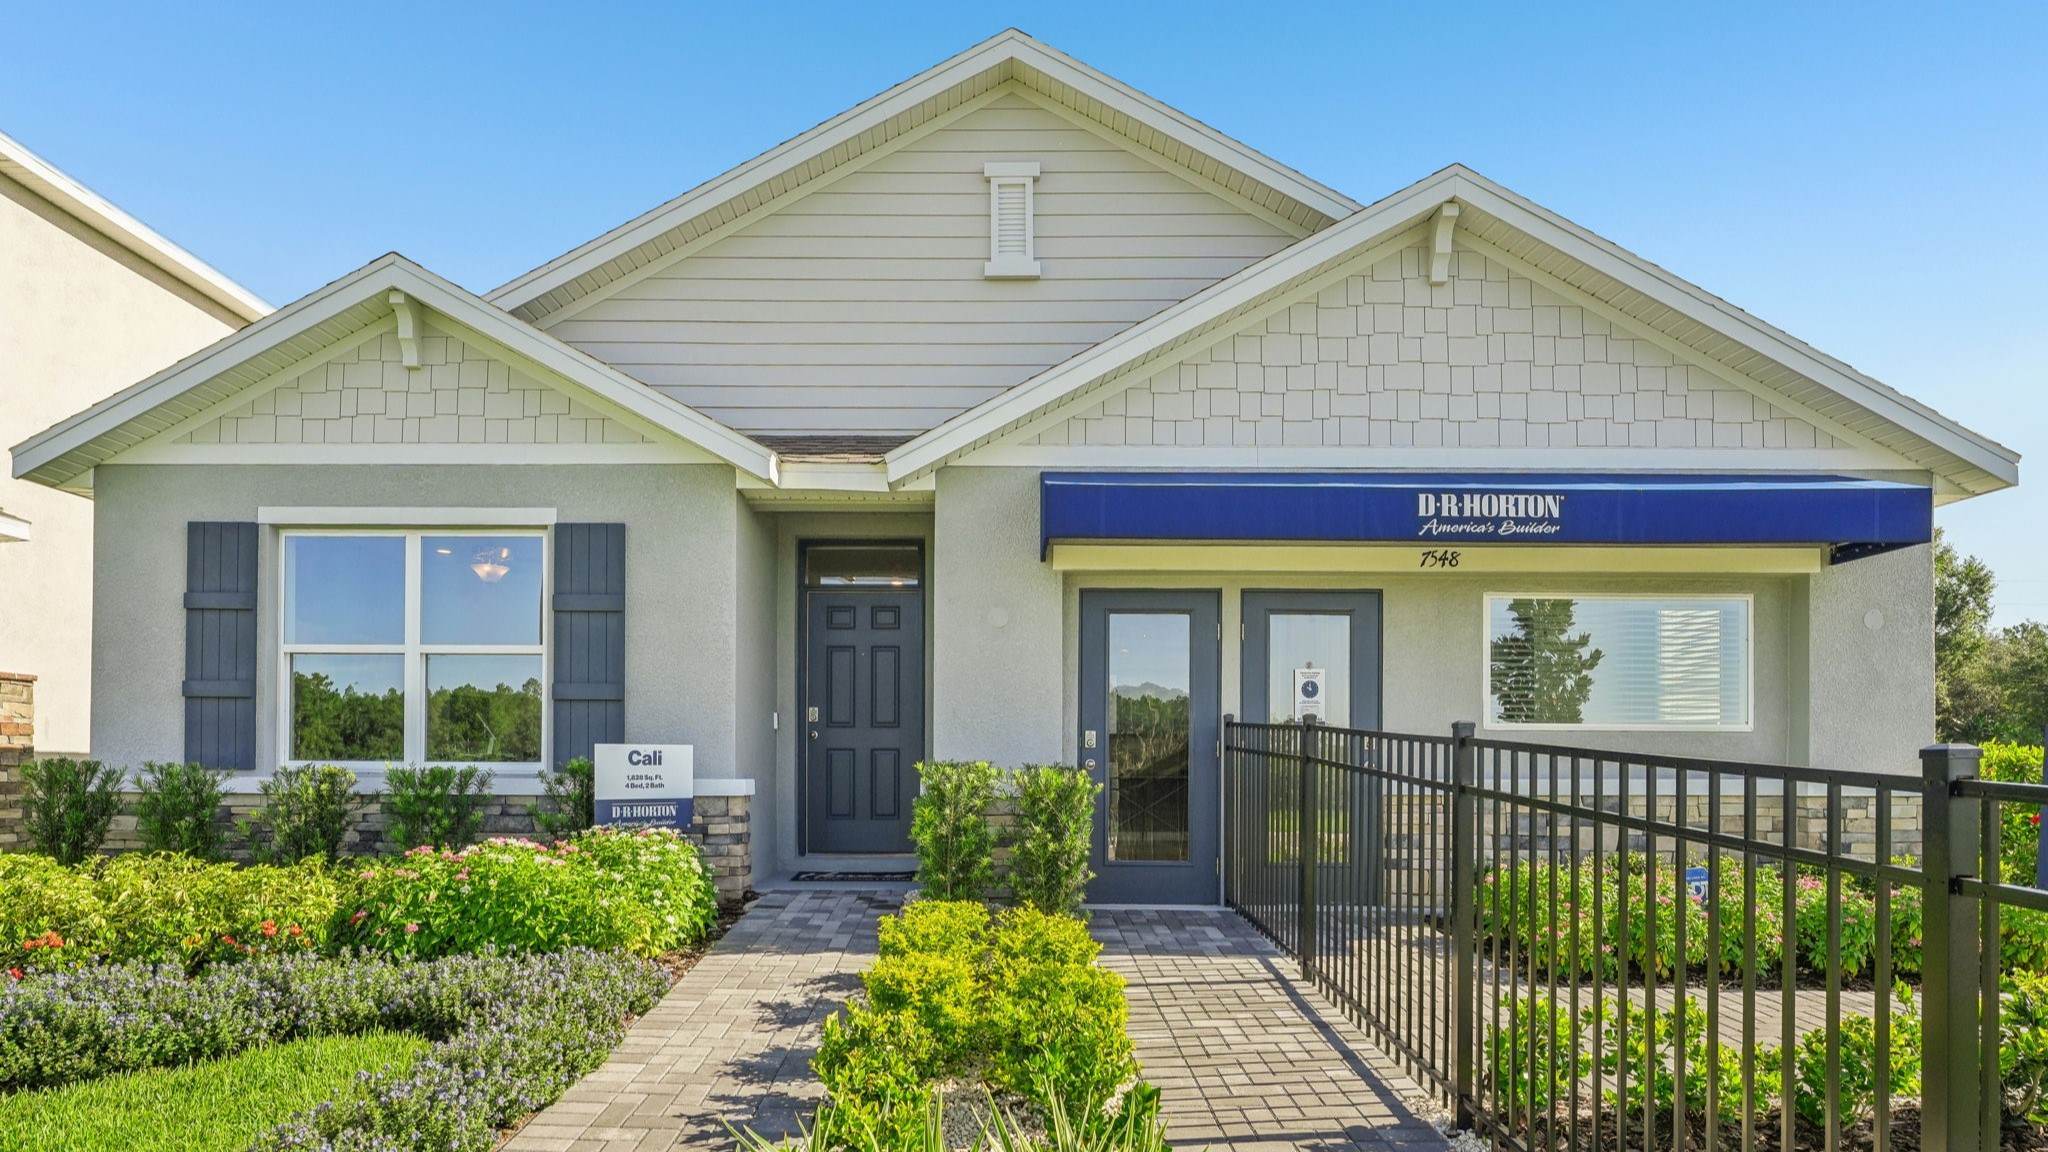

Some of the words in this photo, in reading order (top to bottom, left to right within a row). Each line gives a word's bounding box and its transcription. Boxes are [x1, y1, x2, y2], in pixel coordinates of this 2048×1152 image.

[1418, 518, 1495, 536] America's
[1498, 519, 1561, 535] Builder
[1420, 550, 1461, 568] 7548
[628, 750, 662, 766] Cali
